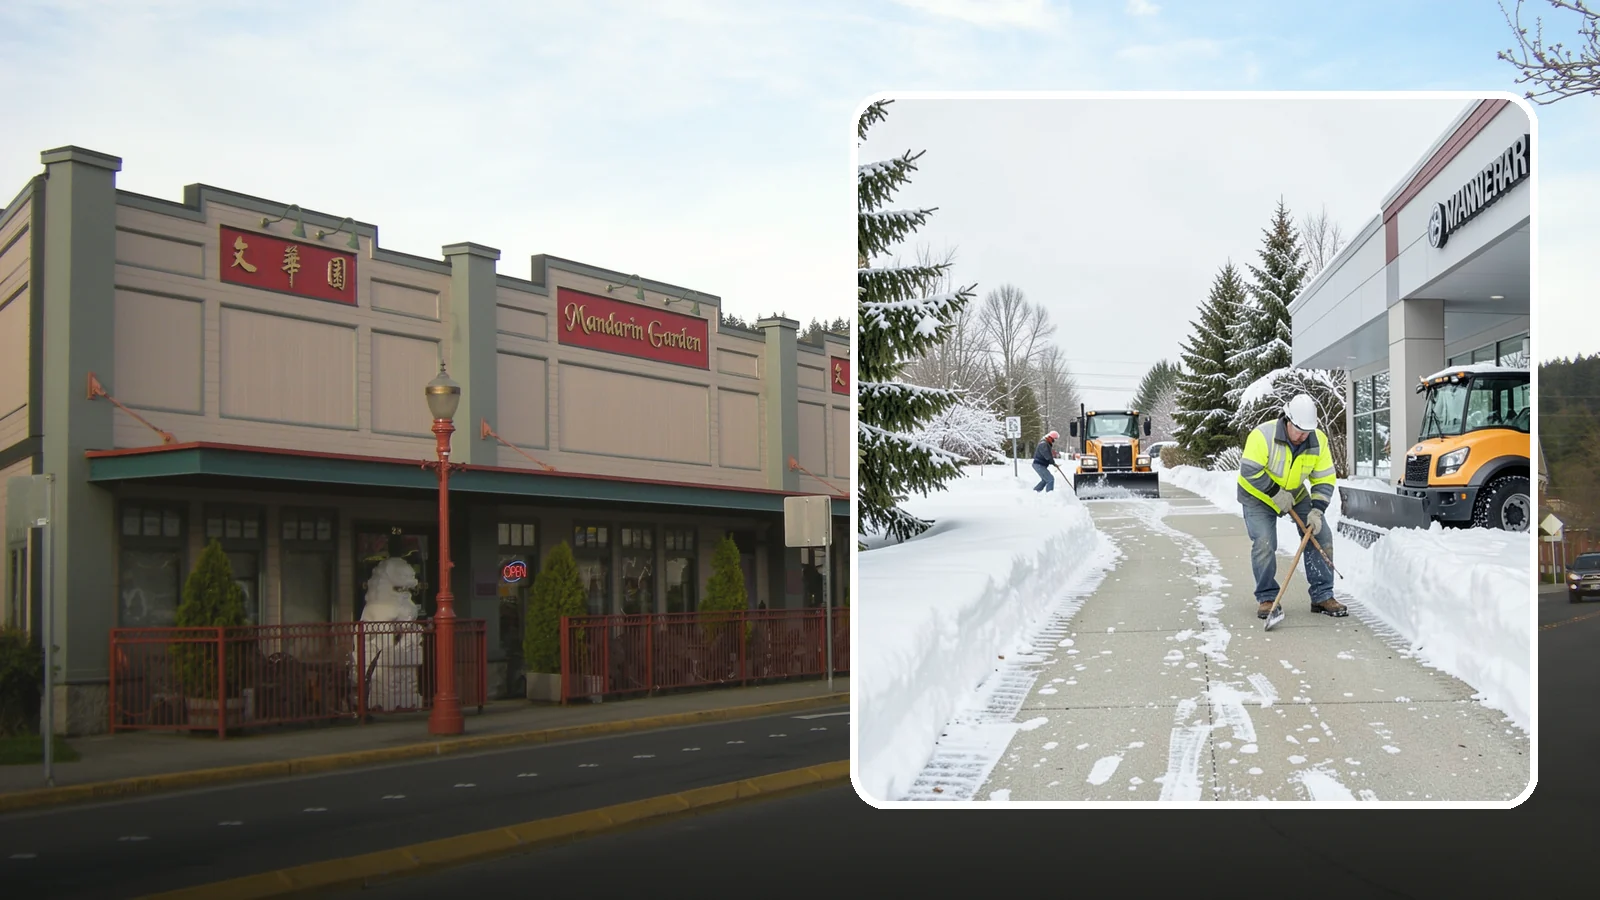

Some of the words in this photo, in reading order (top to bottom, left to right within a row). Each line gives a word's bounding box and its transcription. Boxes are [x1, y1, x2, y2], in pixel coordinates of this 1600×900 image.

[231, 236, 346, 291] 文華園
[565, 302, 644, 340] Mandarin
[648, 320, 702, 352] Garden
[503, 565, 527, 578] OPEN
